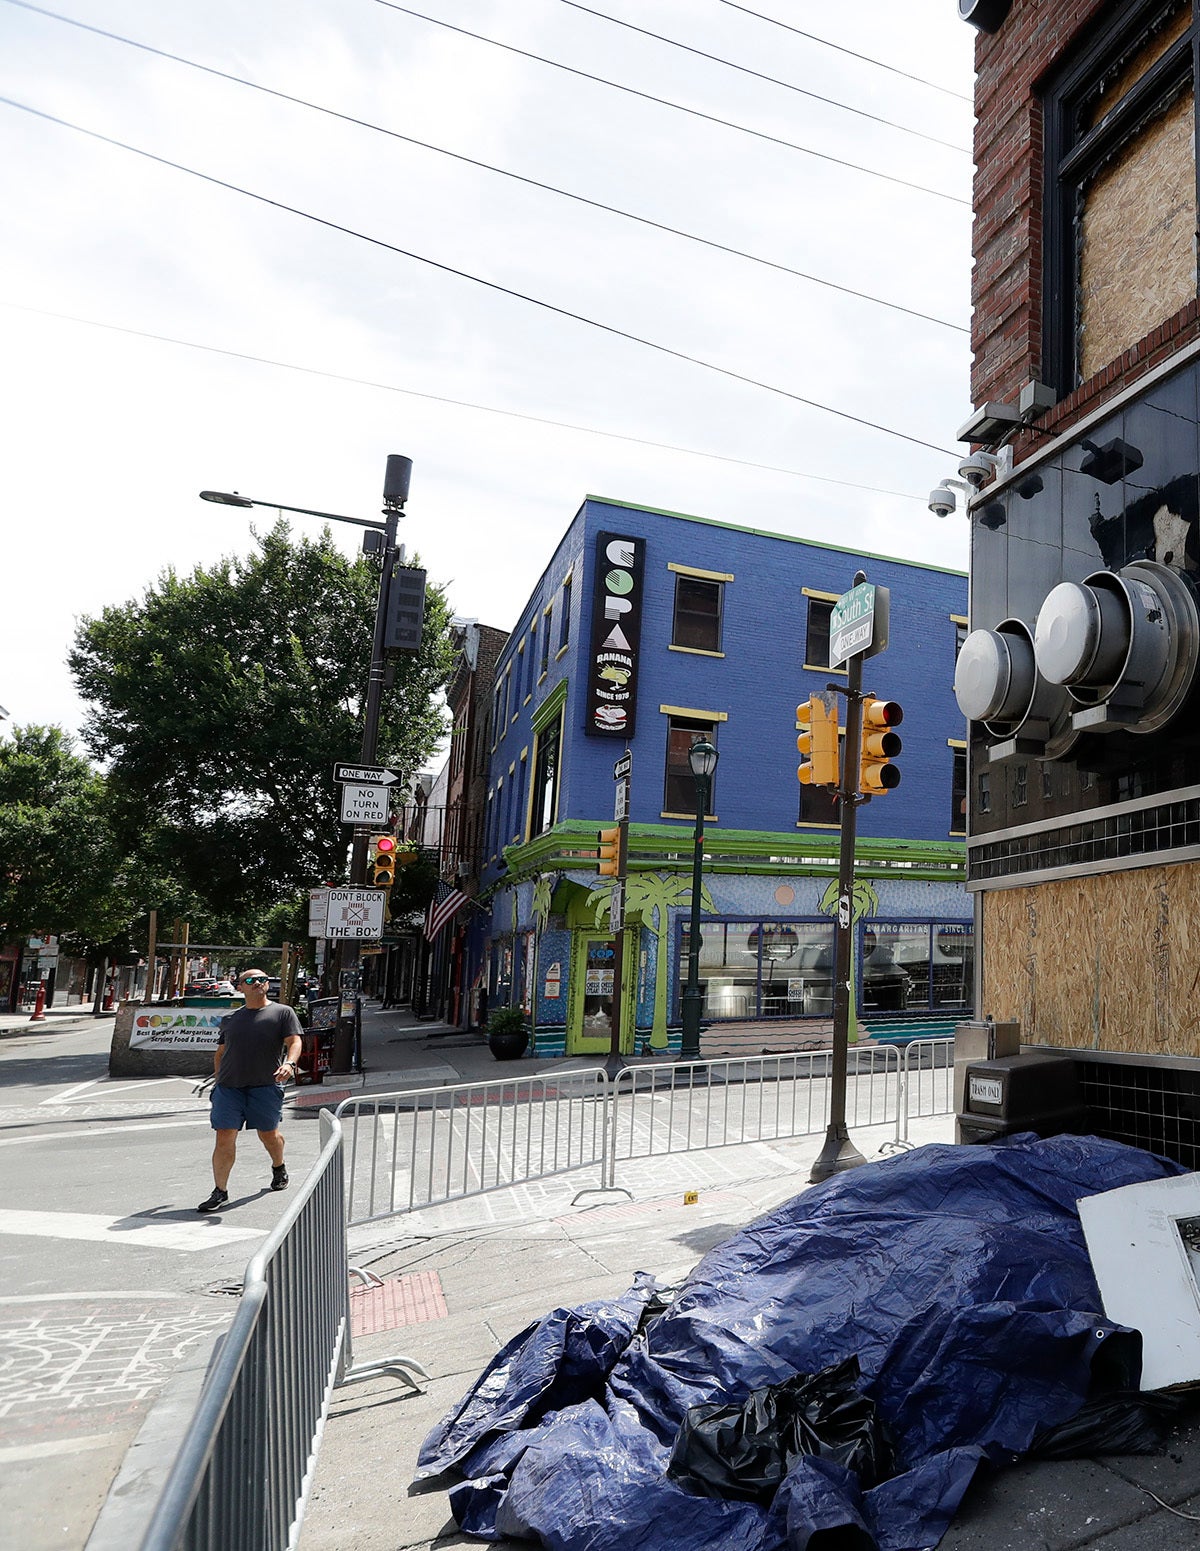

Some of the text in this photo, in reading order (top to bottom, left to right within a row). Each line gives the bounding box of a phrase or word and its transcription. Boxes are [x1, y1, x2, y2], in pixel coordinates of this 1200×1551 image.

[837, 597, 861, 628] South
[864, 590, 873, 613] St
[596, 653, 632, 667] BANANA
[596, 688, 614, 700] SINCE
[342, 769, 382, 780] ONE WAY
[358, 790, 374, 798] NO
[353, 800, 379, 809] TURN
[346, 810, 384, 820] ON RED
[356, 893, 382, 902] BLOCK
[330, 927, 349, 936] THE
[874, 924, 929, 933] MARGARITAS
[945, 925, 965, 933] SINCE
[179, 1029, 212, 1037] Margaritas
[988, 1086, 1000, 1098] ONLY
